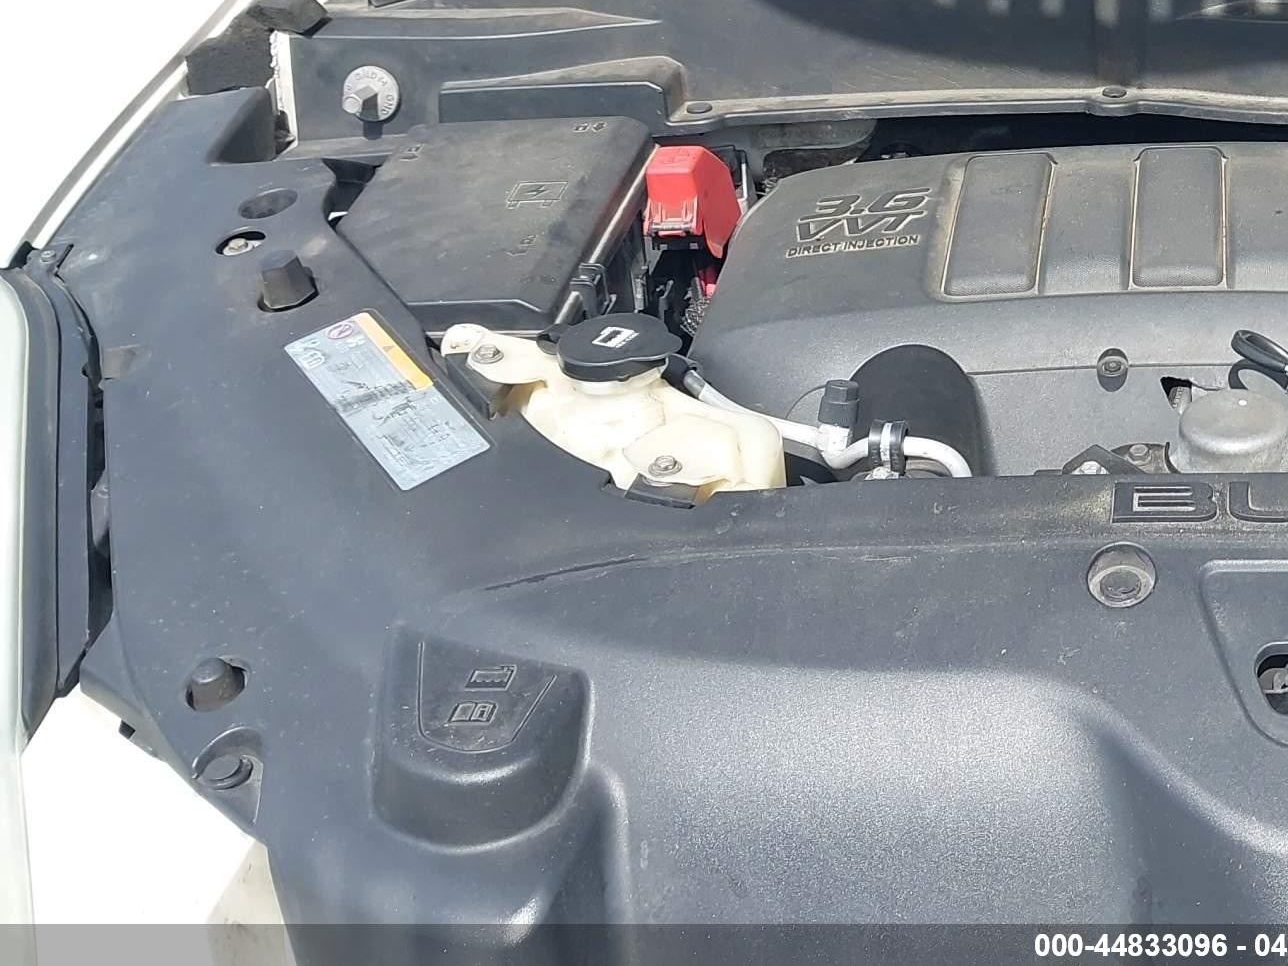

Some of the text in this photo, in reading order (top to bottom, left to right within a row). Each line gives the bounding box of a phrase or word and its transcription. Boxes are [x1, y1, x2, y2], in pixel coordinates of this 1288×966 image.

[798, 187, 932, 222] 3.6
[796, 210, 928, 242] VVT
[786, 234, 920, 258] DIRECT INJECTION
